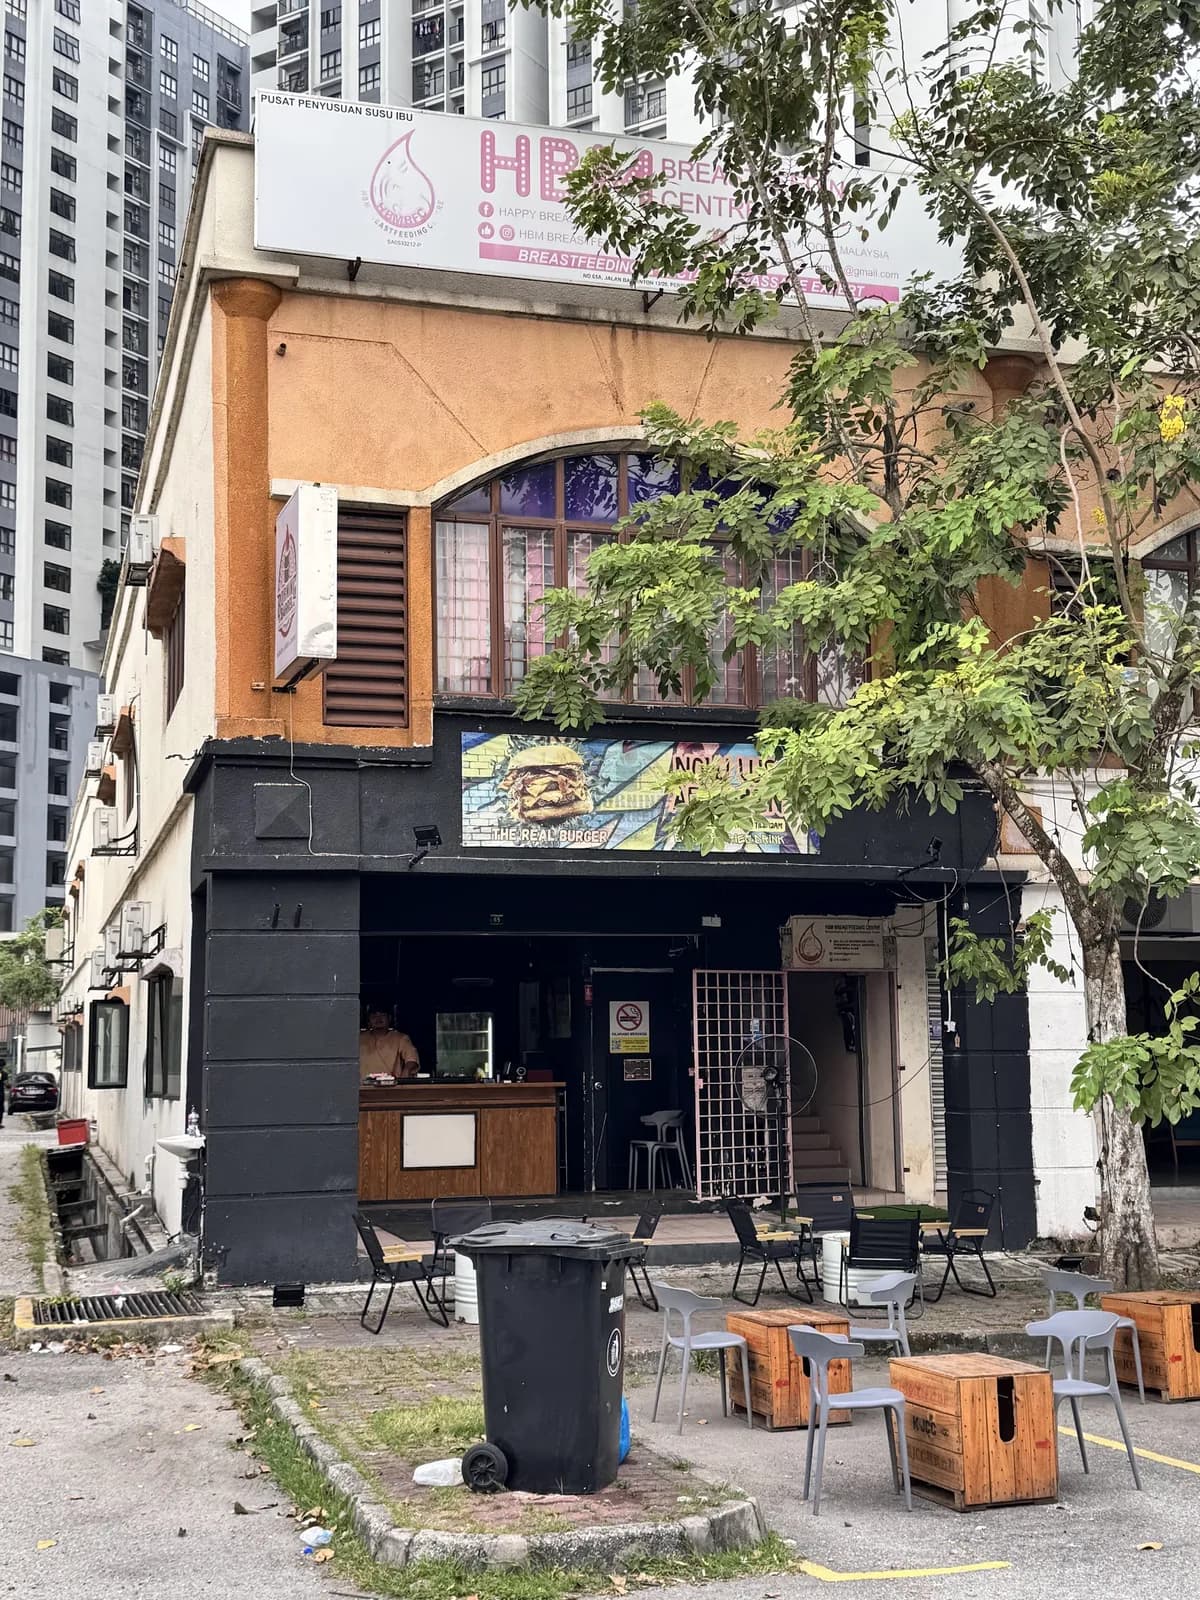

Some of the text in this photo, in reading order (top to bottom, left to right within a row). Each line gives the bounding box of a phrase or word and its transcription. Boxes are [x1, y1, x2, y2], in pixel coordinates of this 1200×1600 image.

[260, 93, 413, 122] PUSAT PENYUSUAN SUSU IBU
[499, 207, 537, 220] HAPPY
[519, 228, 544, 241] HBM
[839, 244, 890, 260] MALAYSIA
[604, 275, 621, 283] JALAN
[623, 278, 654, 287] BANTON
[811, 281, 866, 298] EXERT
[492, 827, 608, 844] THE REAL BURGER
